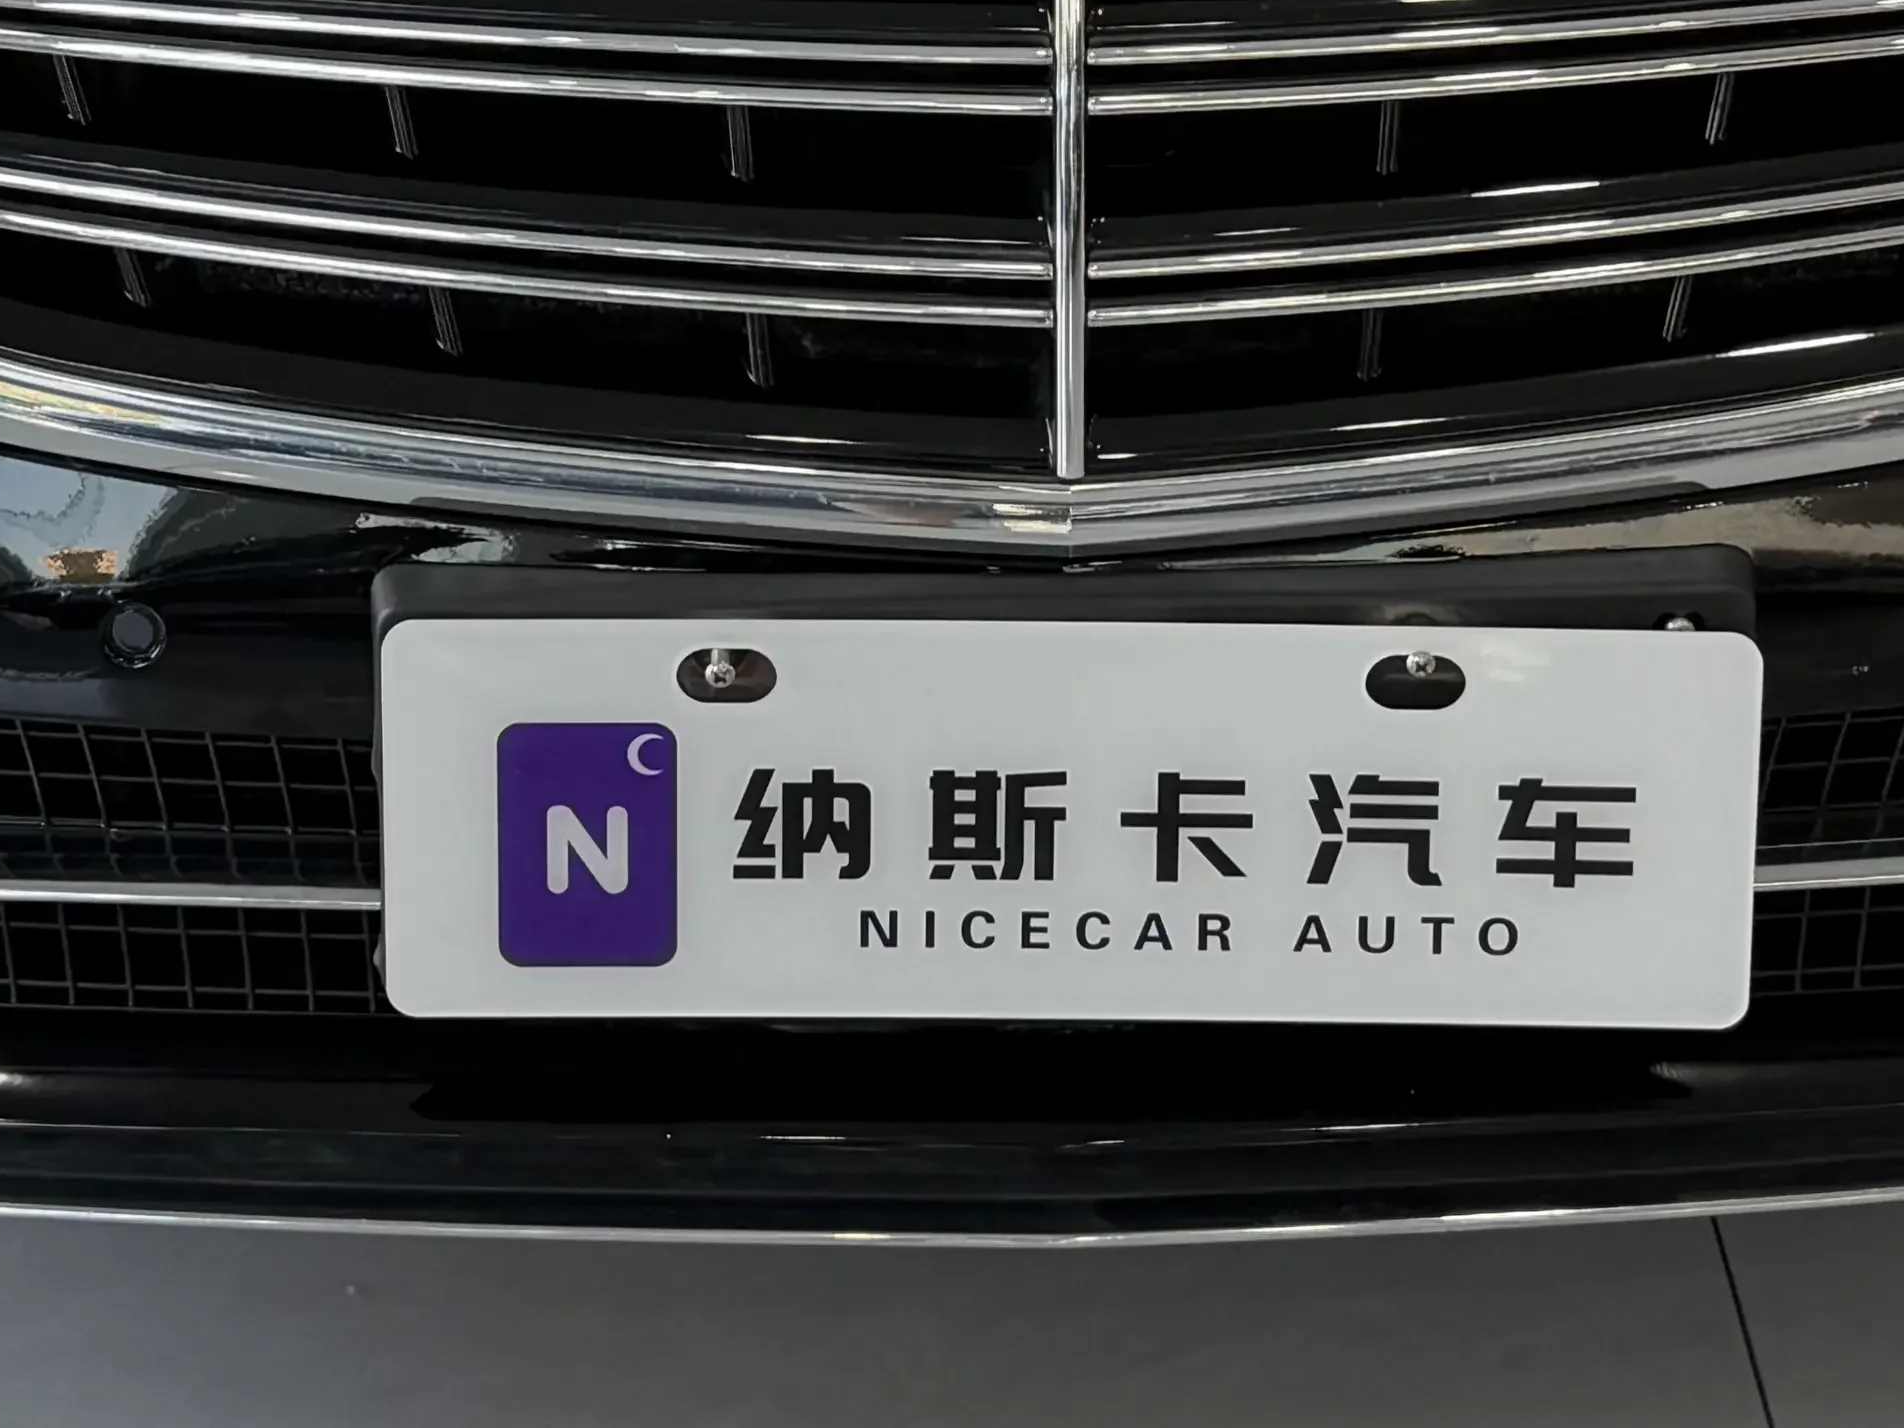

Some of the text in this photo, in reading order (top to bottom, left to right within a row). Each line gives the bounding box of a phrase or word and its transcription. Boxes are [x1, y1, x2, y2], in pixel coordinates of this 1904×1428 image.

[545, 768, 1638, 896] N 纳斯卡汽车
[859, 909, 1521, 958] NICECAR AUTO
